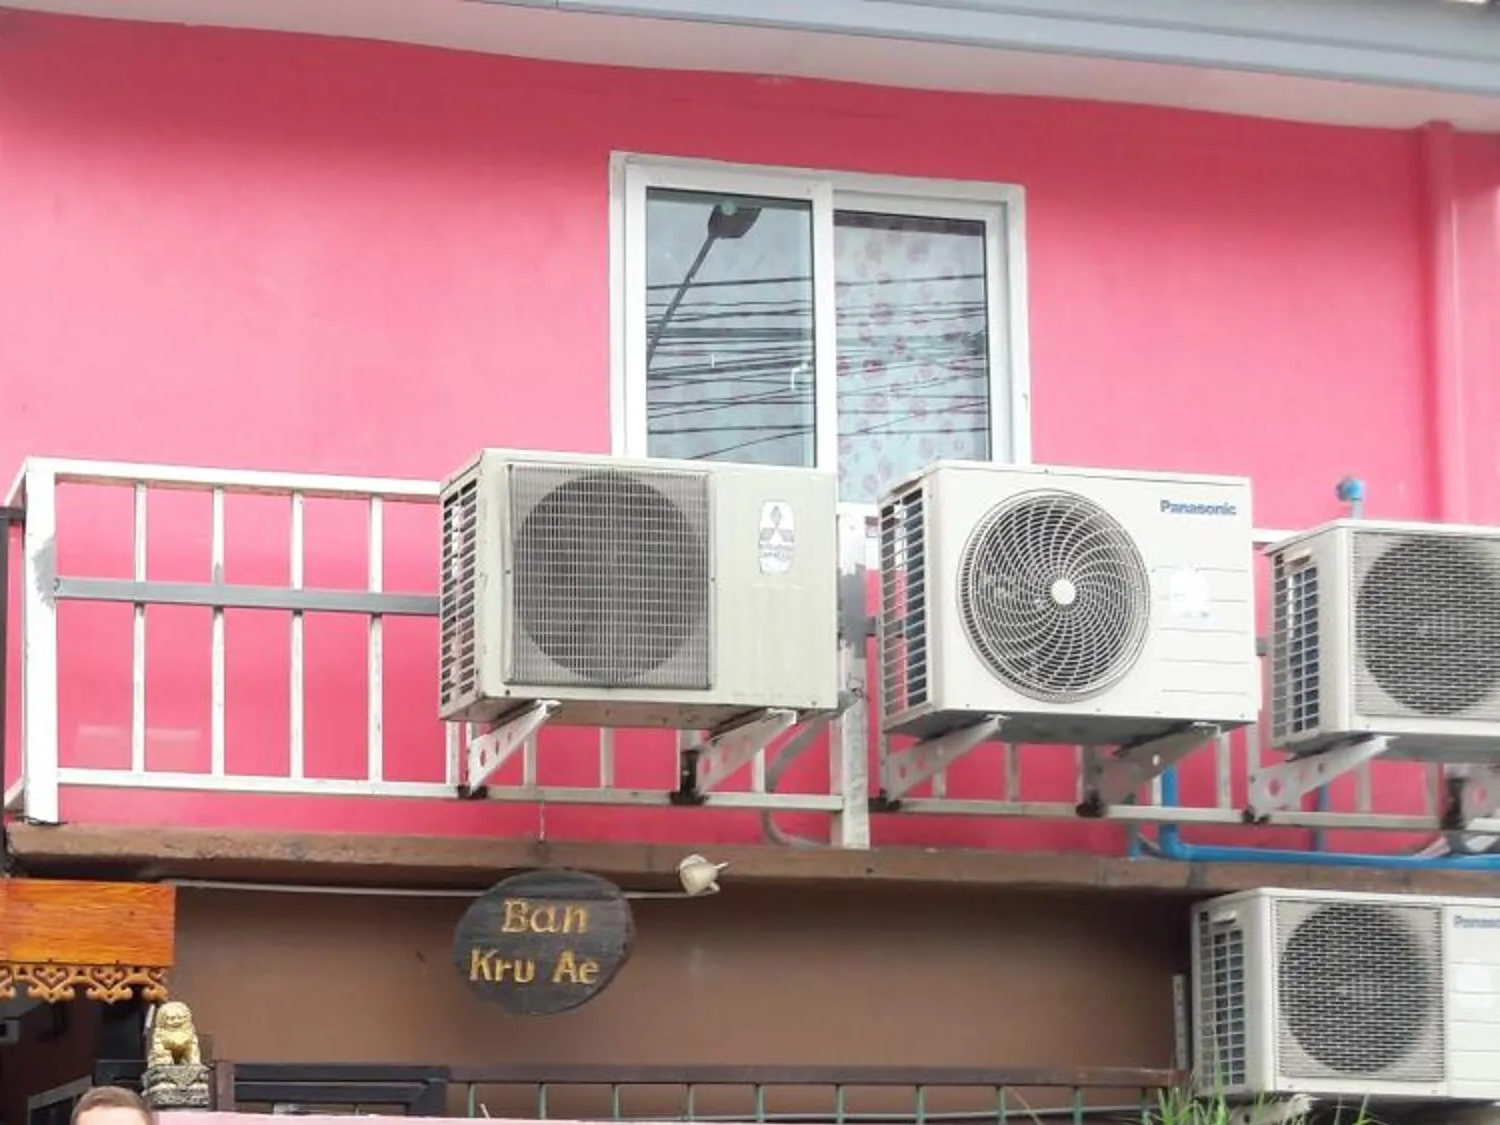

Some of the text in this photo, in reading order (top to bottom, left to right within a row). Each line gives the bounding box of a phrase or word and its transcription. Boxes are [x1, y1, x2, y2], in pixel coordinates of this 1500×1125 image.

[1159, 499, 1237, 515] Panasonic
[501, 898, 589, 934] Ban
[469, 947, 600, 984] Kru Ae
